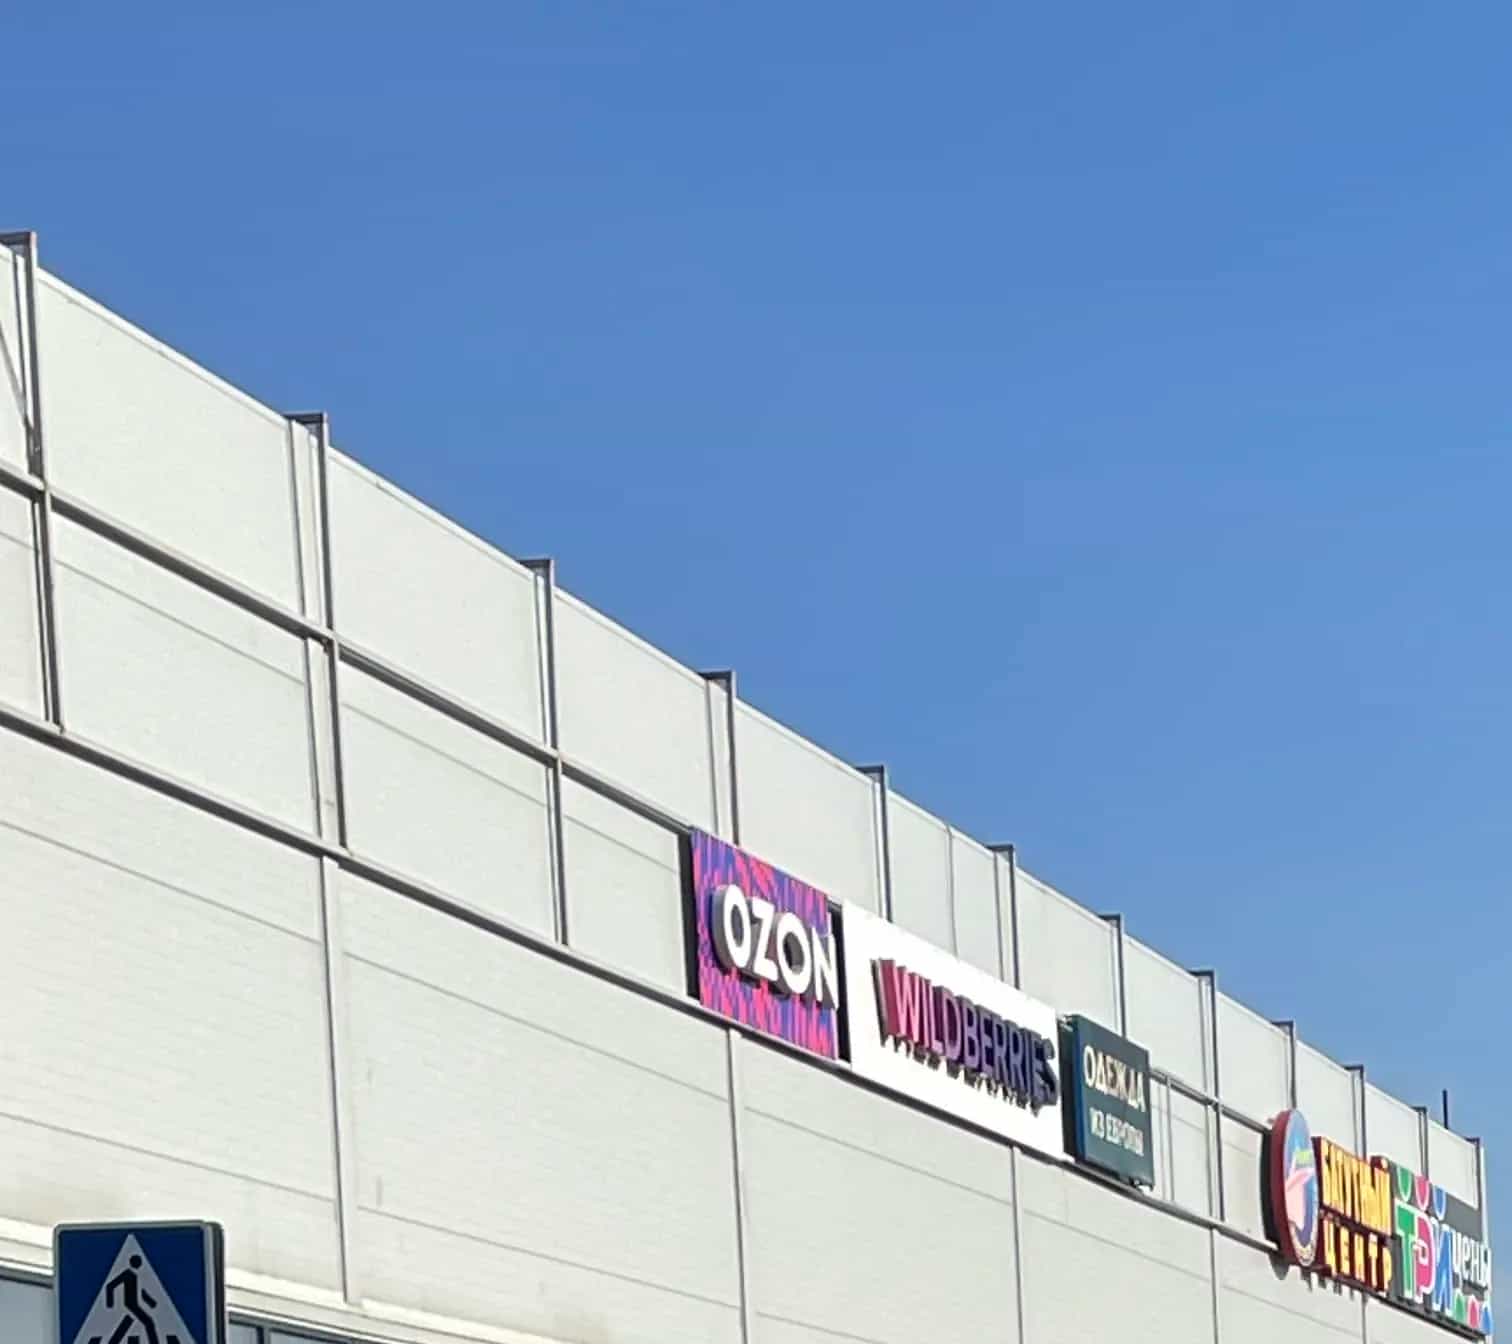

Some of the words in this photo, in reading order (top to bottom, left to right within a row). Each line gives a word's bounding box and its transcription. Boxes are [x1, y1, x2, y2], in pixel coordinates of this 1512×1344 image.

[720, 884, 839, 1010] OZON
[874, 957, 1058, 1107] WILDBERRIES
[1083, 1044, 1146, 1113] ОДЕЖДА
